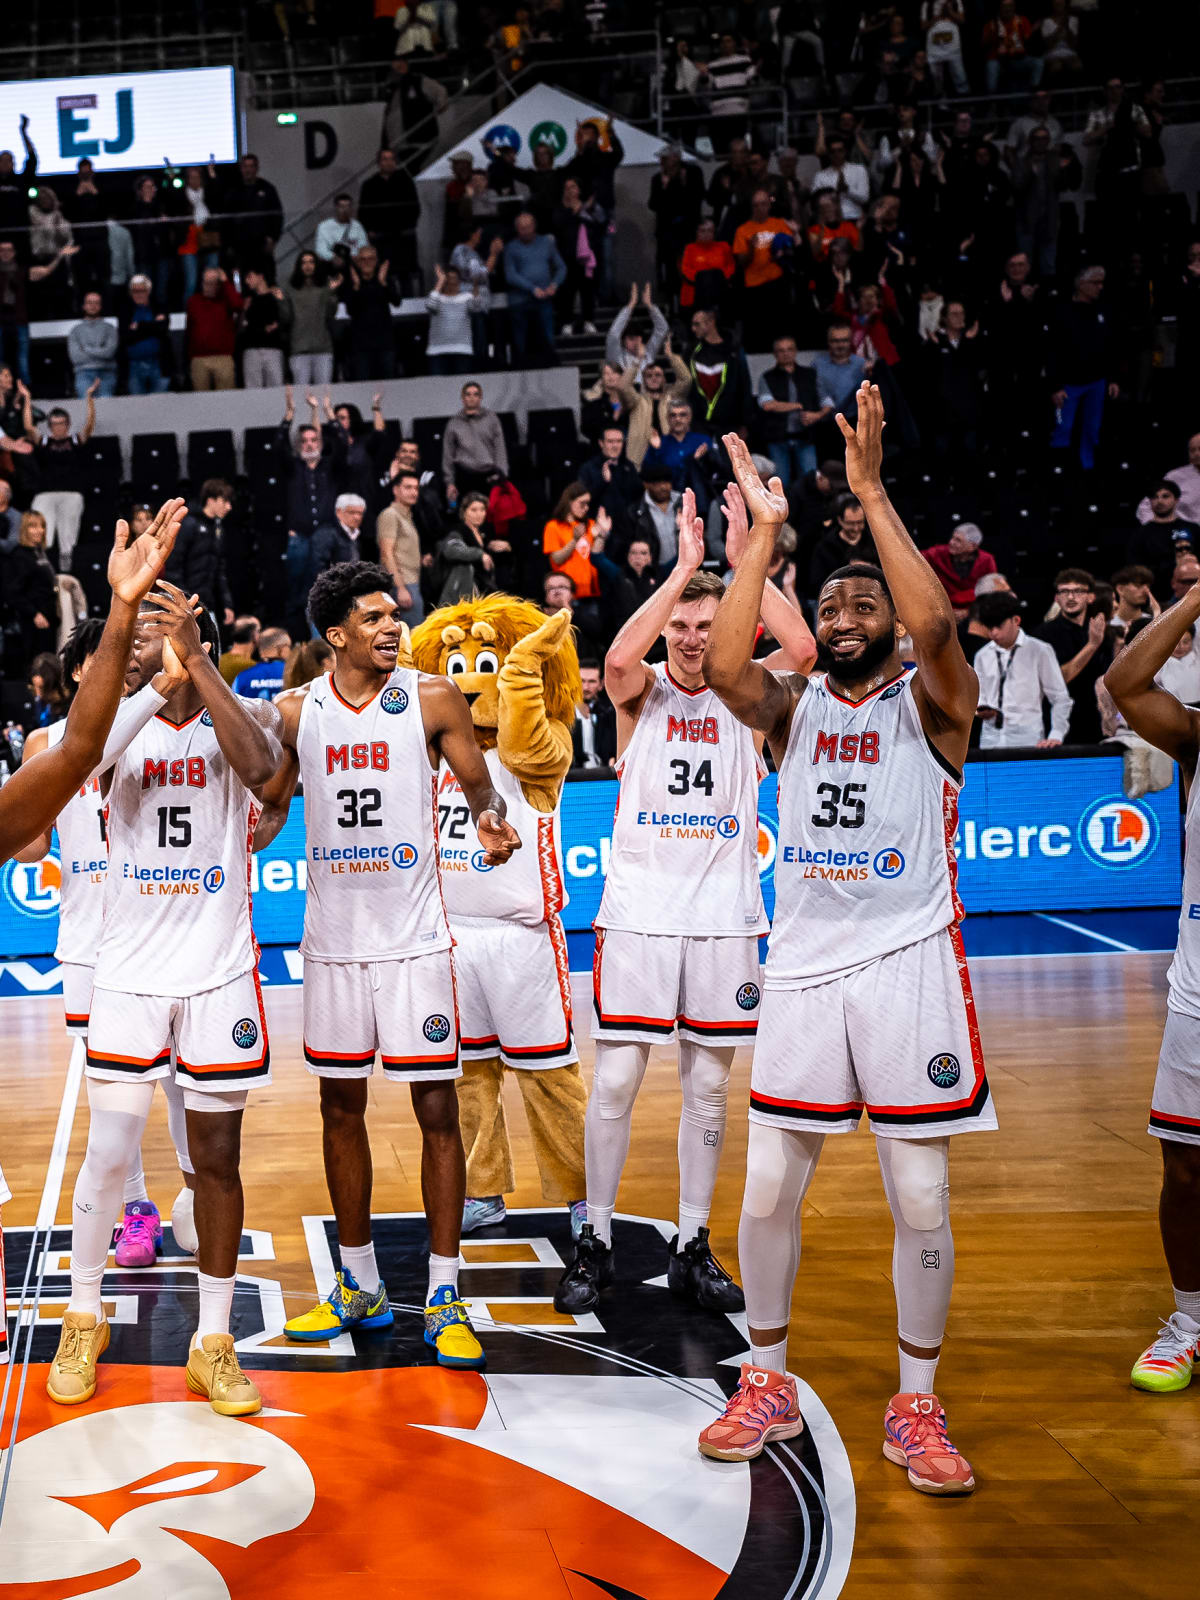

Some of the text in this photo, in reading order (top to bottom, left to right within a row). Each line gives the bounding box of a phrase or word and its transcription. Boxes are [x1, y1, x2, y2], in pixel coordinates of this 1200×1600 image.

[58, 88, 135, 158] EJ
[304, 120, 338, 170] D
[667, 715, 720, 745] MSB
[326, 741, 390, 775] MSB
[812, 730, 880, 765] MSB
[142, 756, 207, 789] MSB
[667, 759, 715, 797] 34
[337, 788, 383, 828] 32
[439, 805, 470, 839] 72
[637, 811, 718, 827] E.Leclerc
[811, 782, 868, 829] 35
[157, 806, 192, 848] 15
[659, 827, 716, 840] LE MANS
[313, 845, 390, 861] E.Leclerc
[331, 861, 390, 874] LE MANS
[783, 846, 870, 866] E.Leclerc
[123, 863, 201, 881] E.Leclerc
[803, 865, 869, 882] LE MANS
[140, 882, 199, 896] LE MANS
